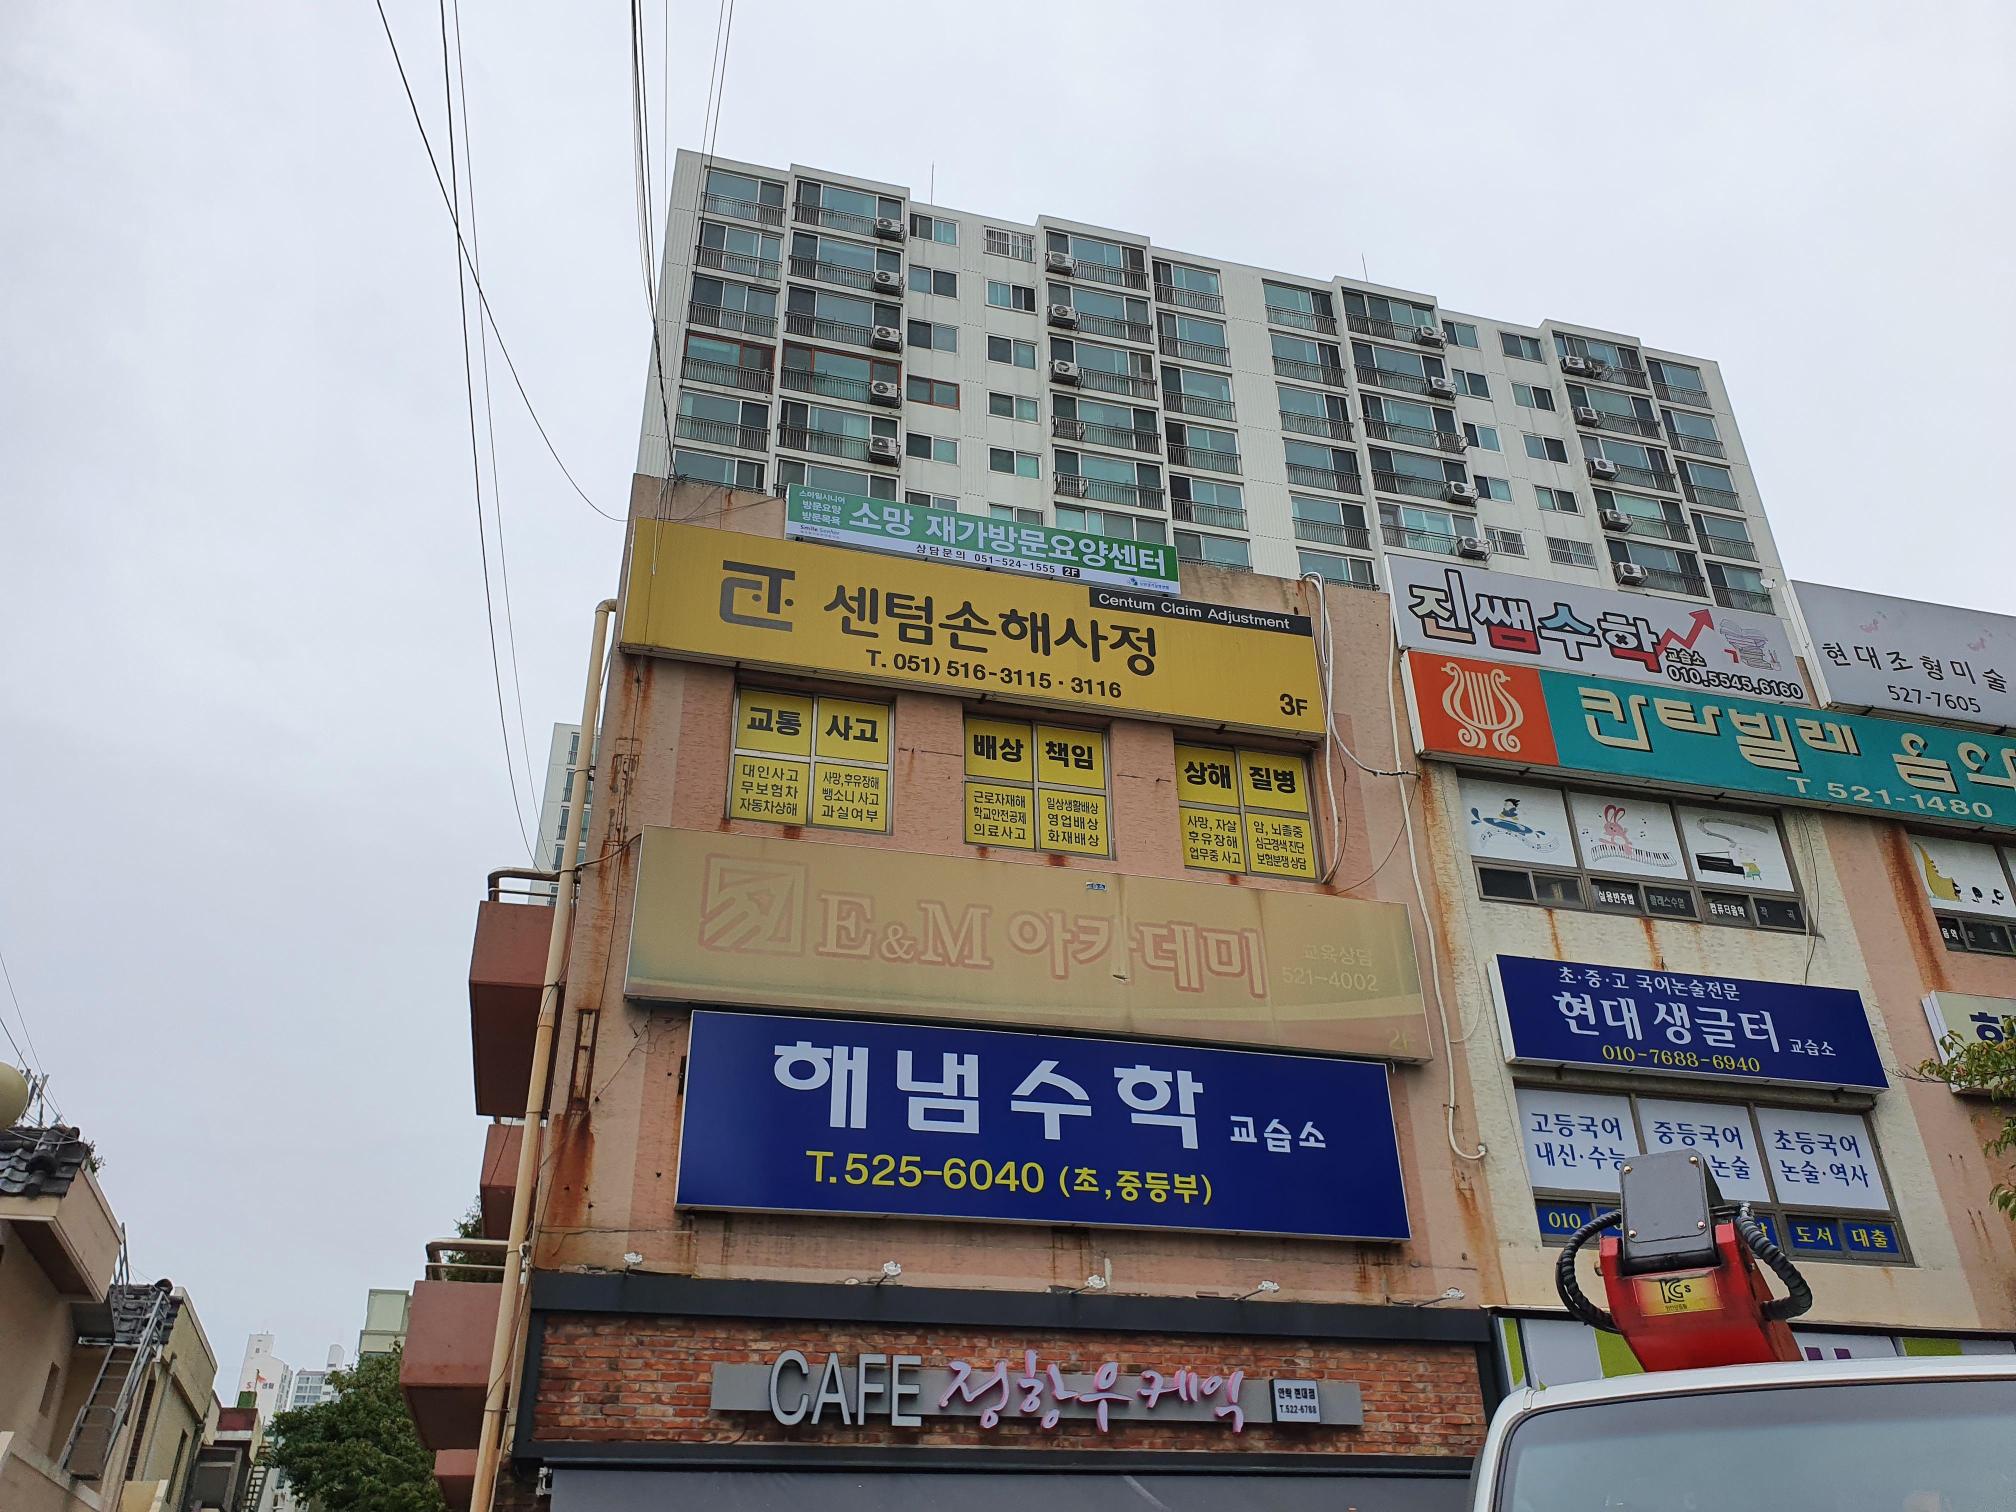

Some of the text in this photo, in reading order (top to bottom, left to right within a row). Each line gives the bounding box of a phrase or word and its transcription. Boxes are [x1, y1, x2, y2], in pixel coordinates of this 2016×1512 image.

[802, 500, 842, 515] 방문요양
[802, 511, 840, 525] 방문목욕
[849, 503, 1166, 577] 소망 재가방문요양센터
[916, 543, 1079, 578] 상담문의 051-524-1555 2F
[1098, 593, 1290, 630] Centum Claim Adjustment
[1408, 568, 1662, 673] 진쌤수학
[824, 585, 1157, 677] 센텀손해사정
[1666, 647, 1708, 668] 교습소
[1822, 642, 2007, 694] 현대조형미술
[1667, 665, 1804, 699] 010.5545.6160
[1280, 694, 1308, 716] 3F
[1887, 685, 1981, 713] 527-7605
[747, 706, 878, 743] 교통 사고
[1578, 686, 1861, 773] 칸타빌레
[973, 734, 1094, 770] 배상 책임
[742, 764, 799, 782] 대인사고
[1184, 761, 1296, 794] 상해 질병
[740, 781, 798, 799] 무보험차
[822, 788, 879, 806] 뺑소니 사고
[974, 790, 1026, 808] 근로자재해
[1827, 782, 1993, 818] 521-1480
[740, 798, 797, 816] 자동차상해
[821, 804, 879, 823] 과실여부
[974, 806, 1027, 824] 학교안전공제
[1047, 797, 1099, 815] 일상생활배상
[973, 823, 1026, 840] 의료사고
[1048, 813, 1099, 831] 영업배상
[1216, 819, 1237, 833] 자살
[1271, 824, 1303, 838] 뇌졸중
[1048, 829, 1100, 847] 화재배상
[1188, 831, 1238, 849] 후유장해
[1189, 847, 1241, 865] 업무중 사고
[1291, 856, 1307, 870] 상담
[815, 890, 994, 970] E&M
[1007, 910, 1269, 1000] 아카데미
[1282, 966, 1380, 992] 521-4002
[1636, 974, 1740, 1001] 국어논술전문
[1602, 1044, 1760, 1072] 010-7688-6940
[1789, 1038, 1836, 1057] 교습소
[774, 1041, 1327, 1153] 해냄수학 교습소
[1531, 1112, 1623, 1141] 고등국어
[1654, 1121, 1743, 1150] 중등국어
[1774, 1129, 1861, 1159] 초등국어
[805, 1150, 1212, 1206] T.525-6040 (초,중등부)
[1780, 1160, 1869, 1188] 논술·역사
[1549, 1212, 1581, 1229] 010
[1796, 1226, 1888, 1249] 도서 대출
[769, 1350, 922, 1427] CAFE
